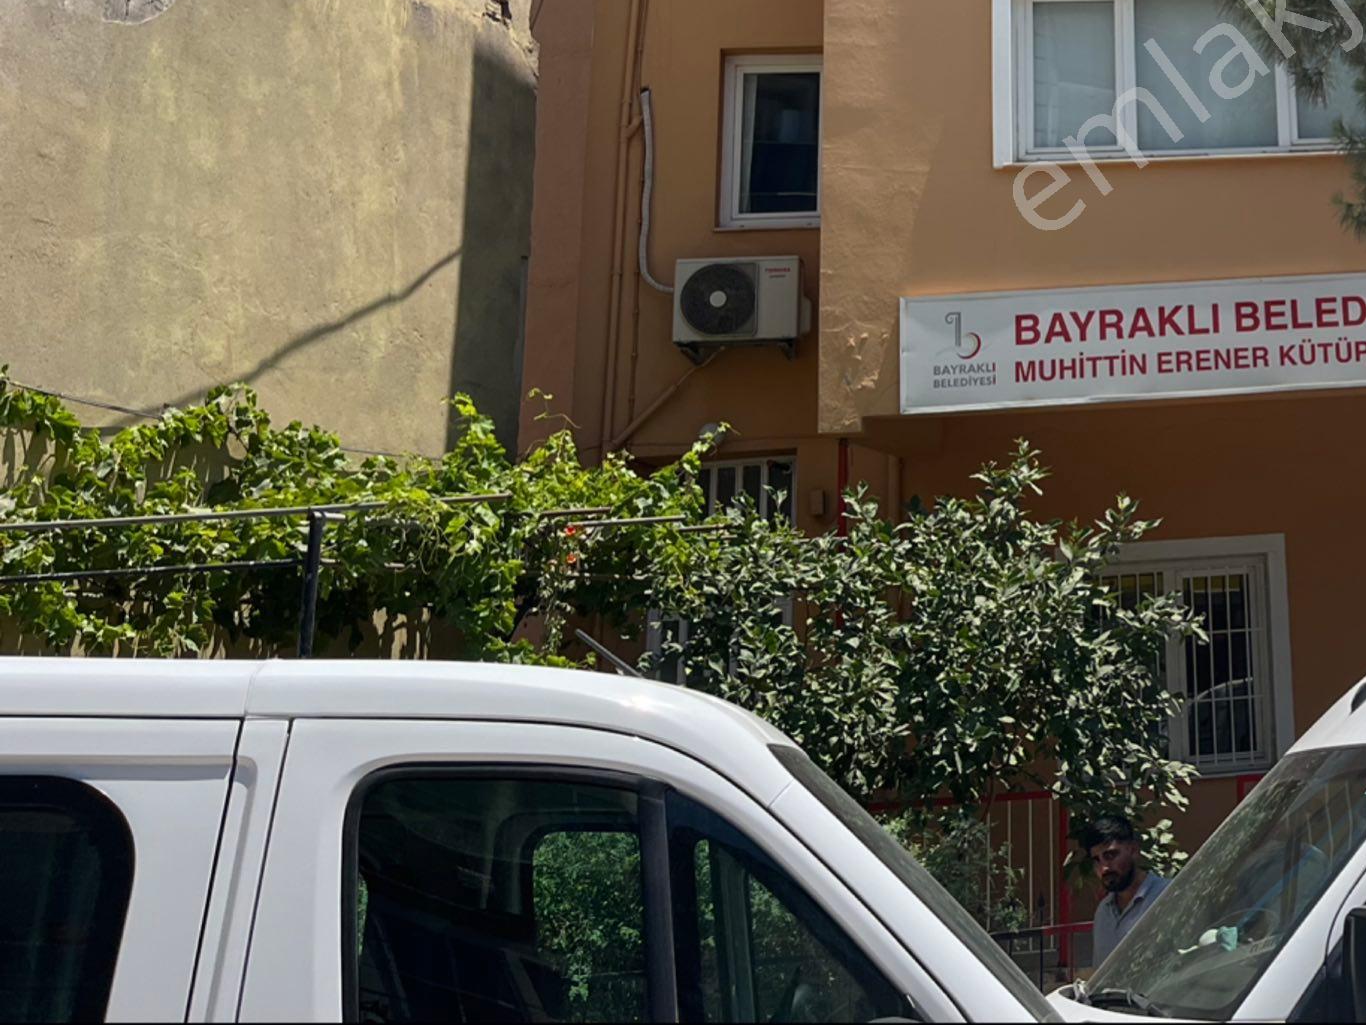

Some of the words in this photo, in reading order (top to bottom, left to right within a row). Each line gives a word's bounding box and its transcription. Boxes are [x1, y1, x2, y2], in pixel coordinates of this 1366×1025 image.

[1014, 303, 1220, 346] BAYRAKLI
[933, 362, 996, 376] BAYRAKLI
[1014, 349, 1147, 383] MUHİTTİN
[1157, 346, 1269, 374] ERENER
[933, 374, 997, 389] BELEDİYESİ
